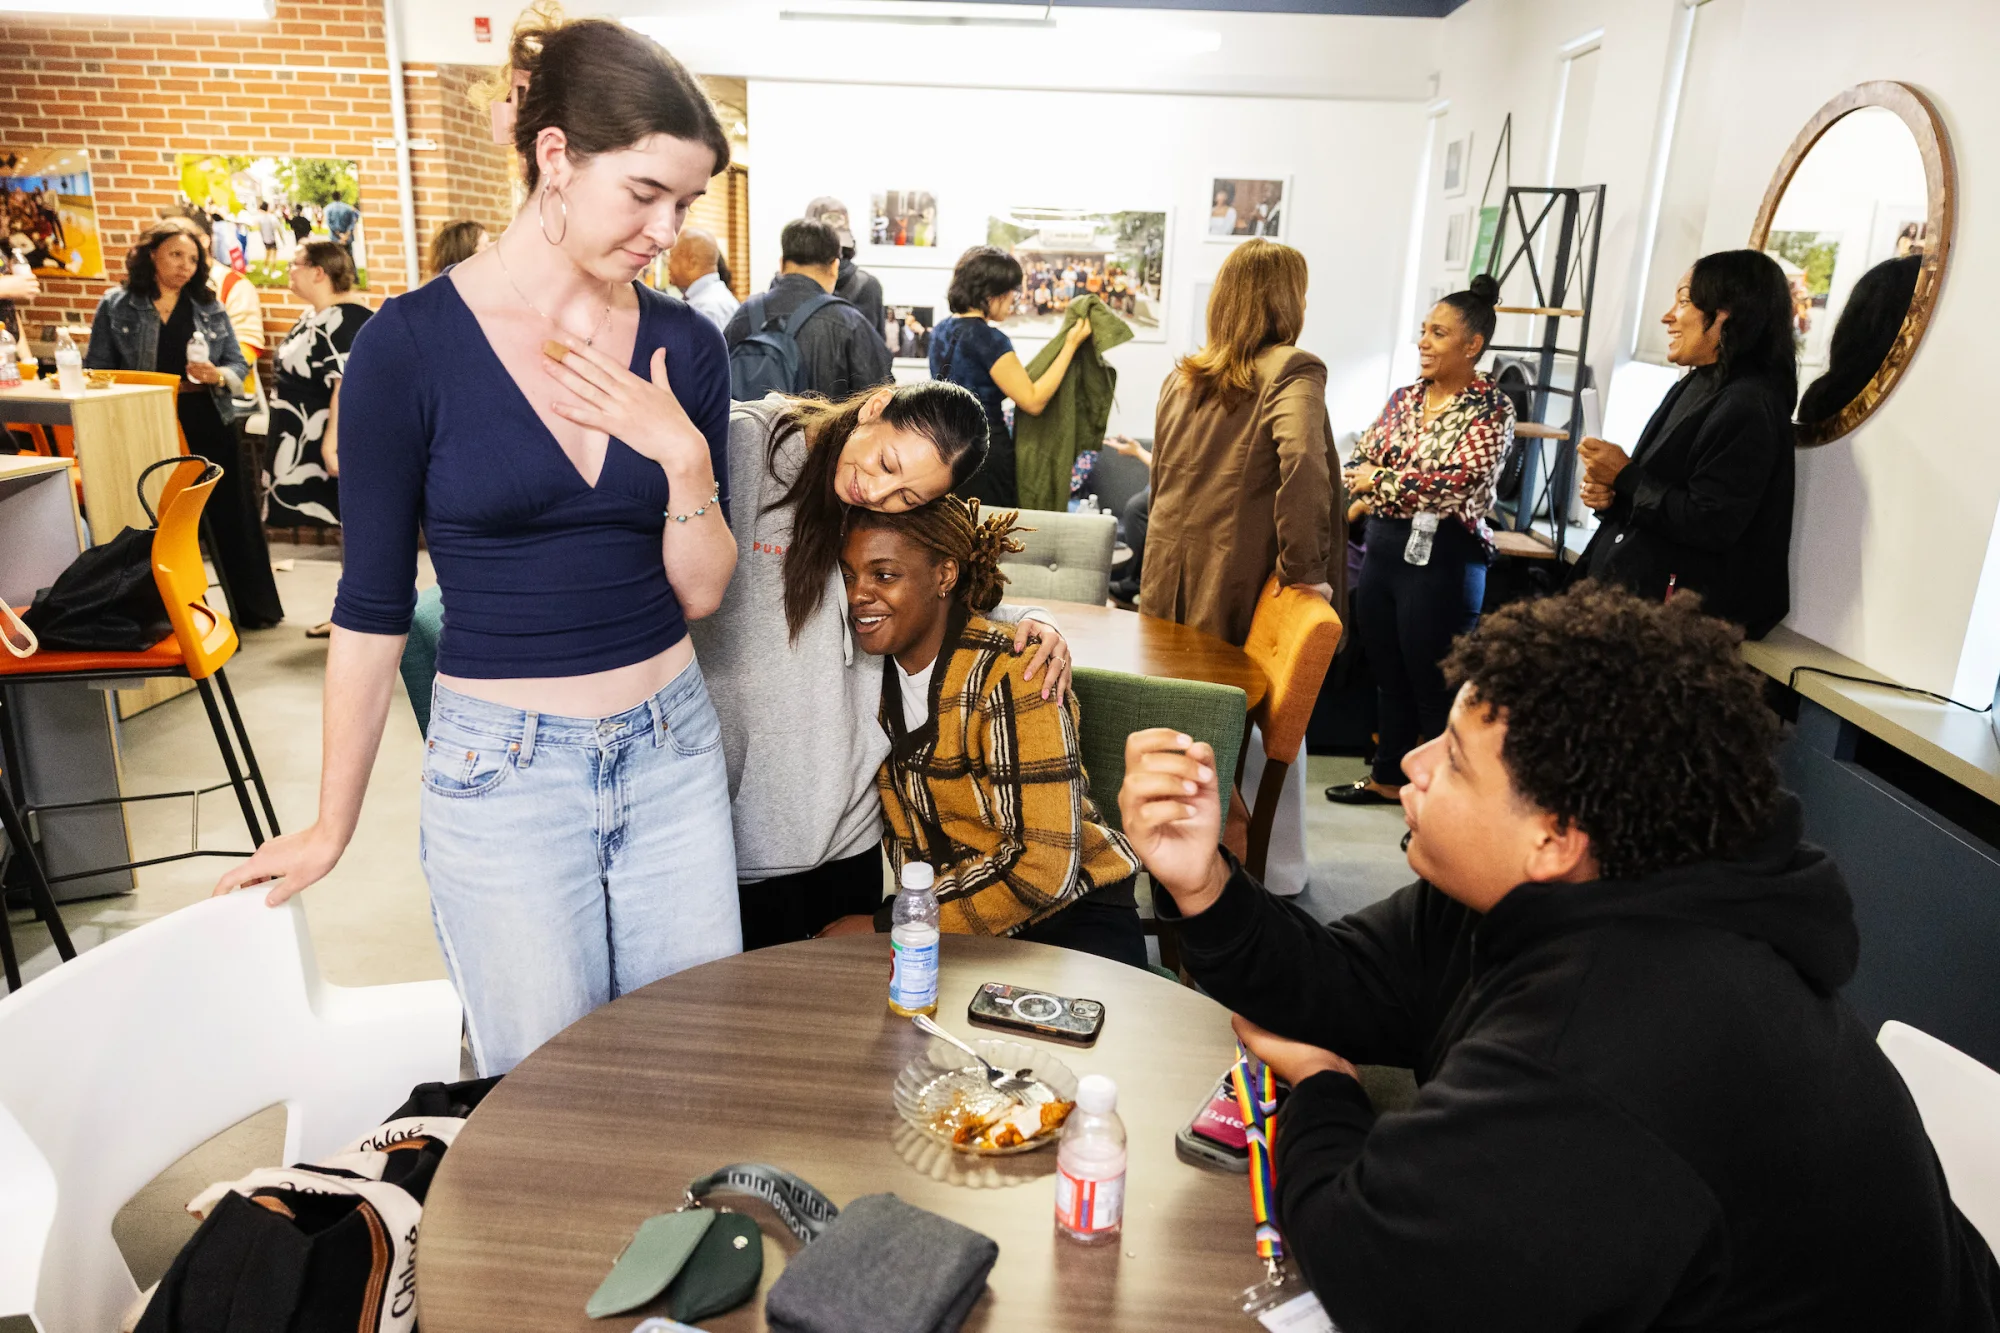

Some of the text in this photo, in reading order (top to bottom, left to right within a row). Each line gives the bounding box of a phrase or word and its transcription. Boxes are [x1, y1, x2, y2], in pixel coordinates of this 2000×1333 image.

[753, 541, 790, 556] PUR
[1203, 1109, 1246, 1131] Bate
[728, 1170, 812, 1245] lululemon
